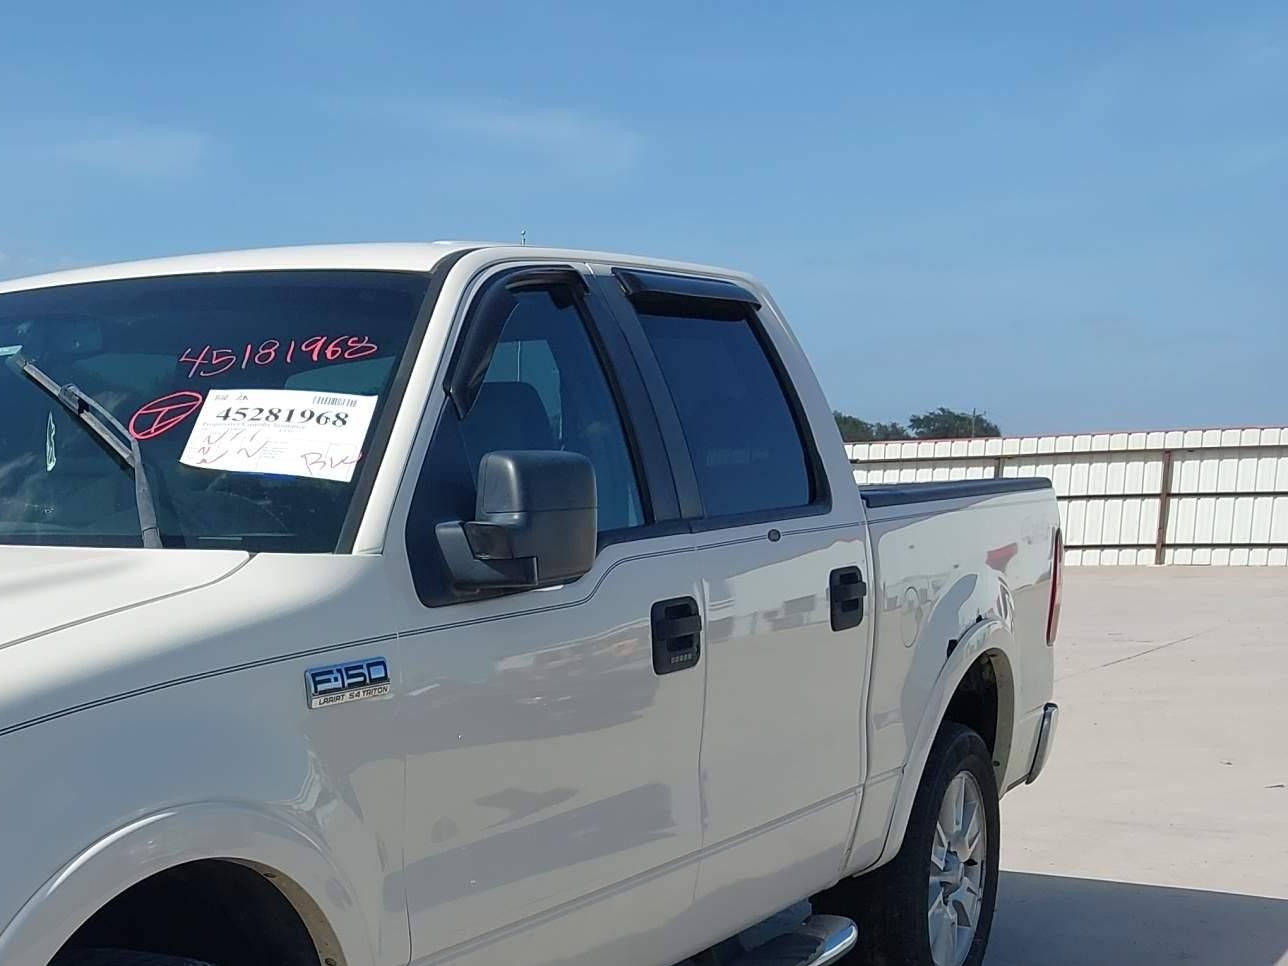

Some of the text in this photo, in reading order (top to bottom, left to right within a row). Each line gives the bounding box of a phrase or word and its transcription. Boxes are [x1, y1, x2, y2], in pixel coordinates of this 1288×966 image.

[177, 335, 379, 379] 45181968
[215, 406, 350, 428] 45281968
[318, 694, 346, 706] LARIAT
[362, 685, 389, 697] TRITON
